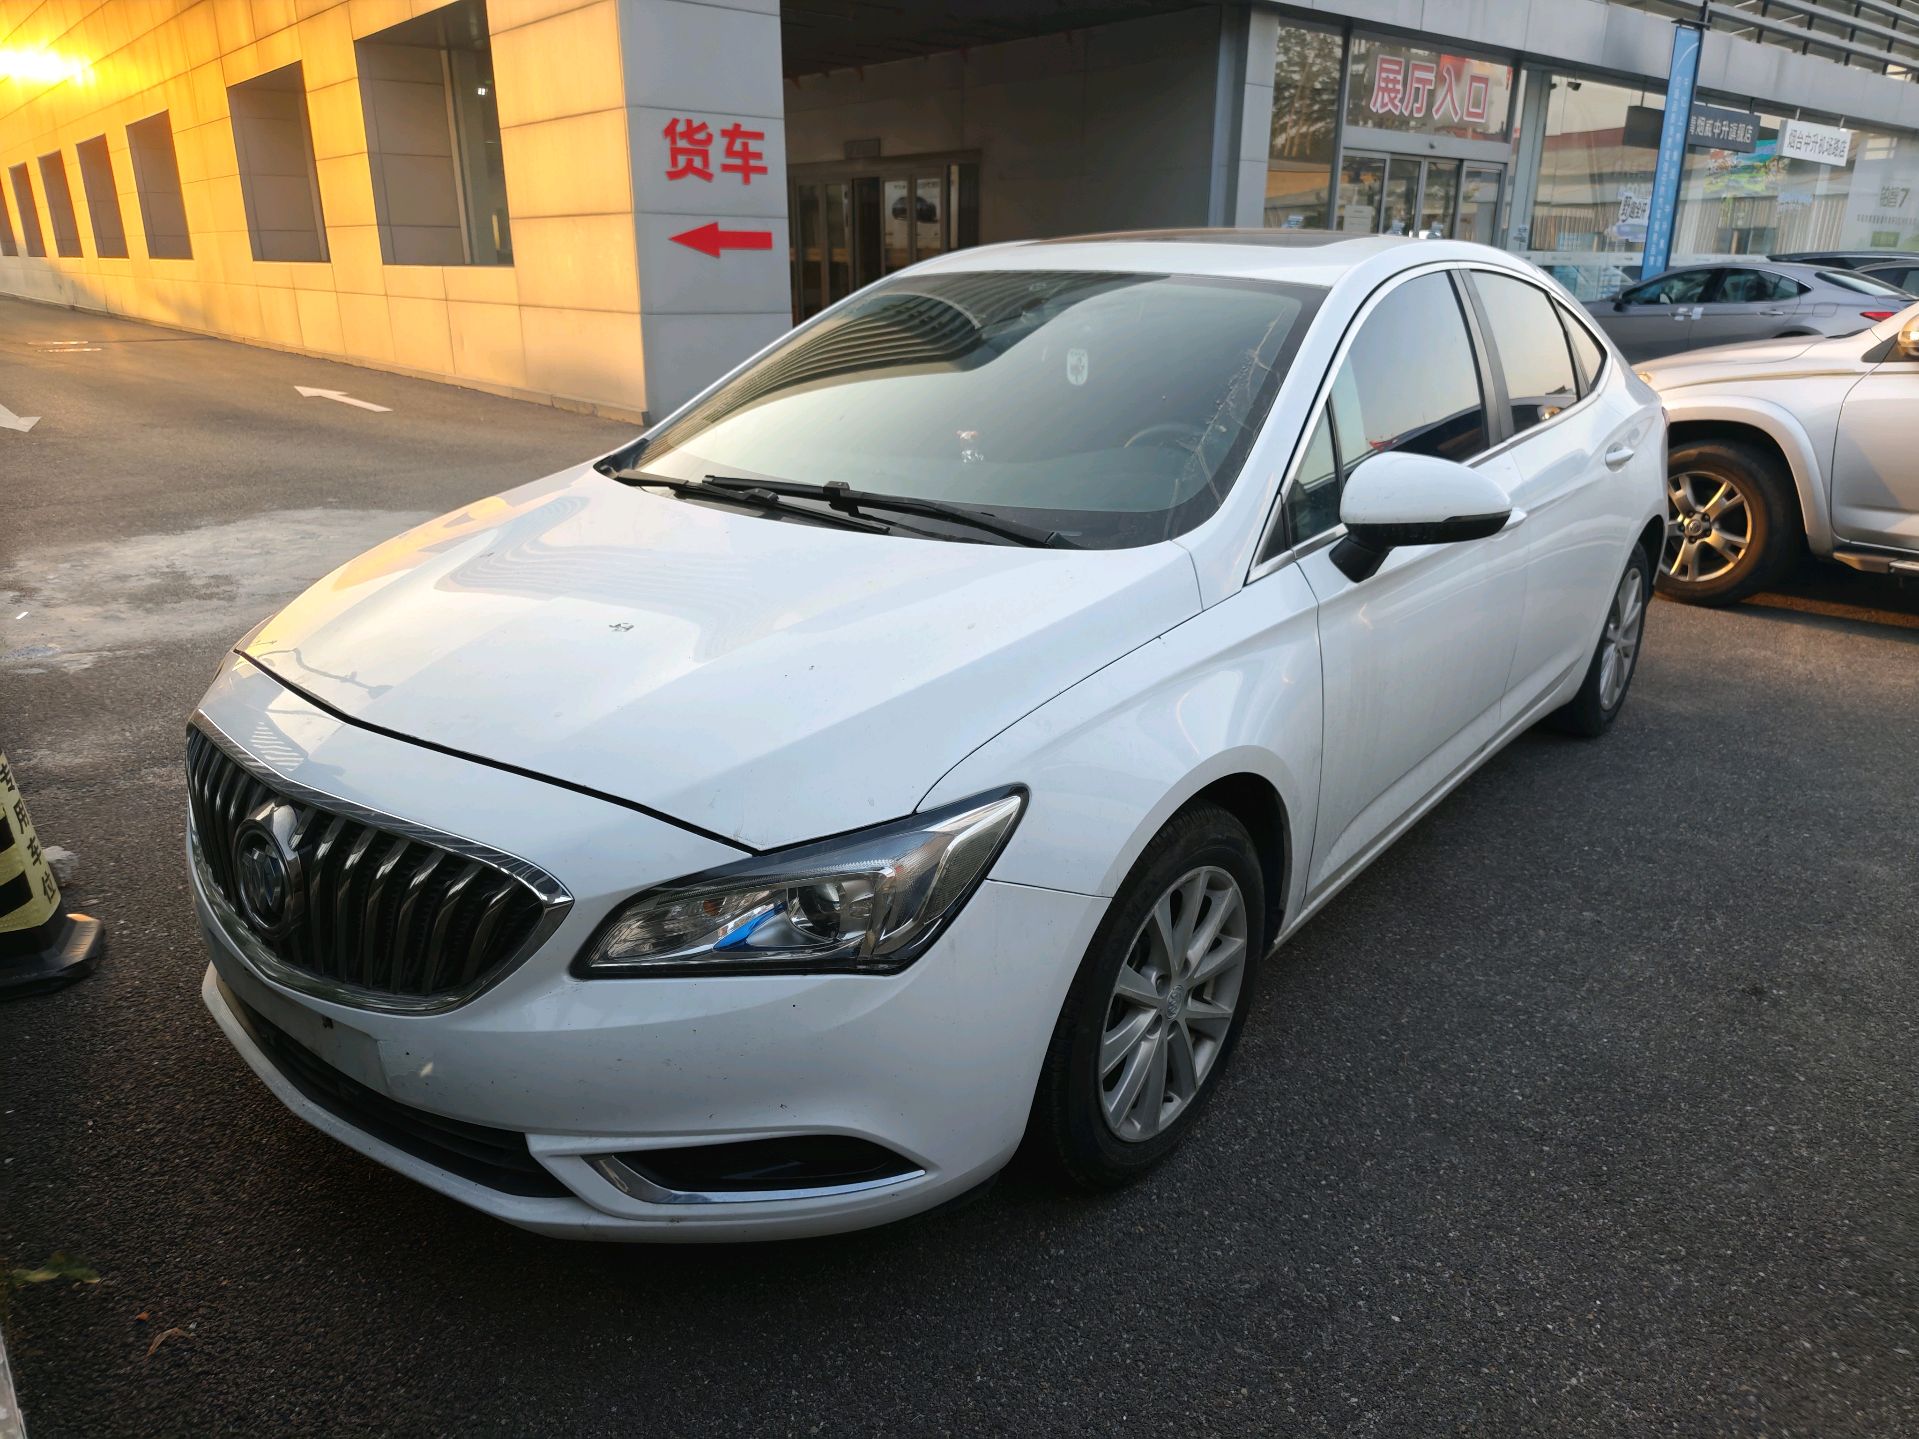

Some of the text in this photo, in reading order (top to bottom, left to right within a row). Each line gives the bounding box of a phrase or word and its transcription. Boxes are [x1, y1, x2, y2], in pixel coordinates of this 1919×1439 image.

[1370, 55, 1489, 122] 展厅入口
[663, 118, 768, 185] 货车
[1787, 128, 1848, 158] 烟台中升机场路店
[0, 763, 57, 905] 专用车位
